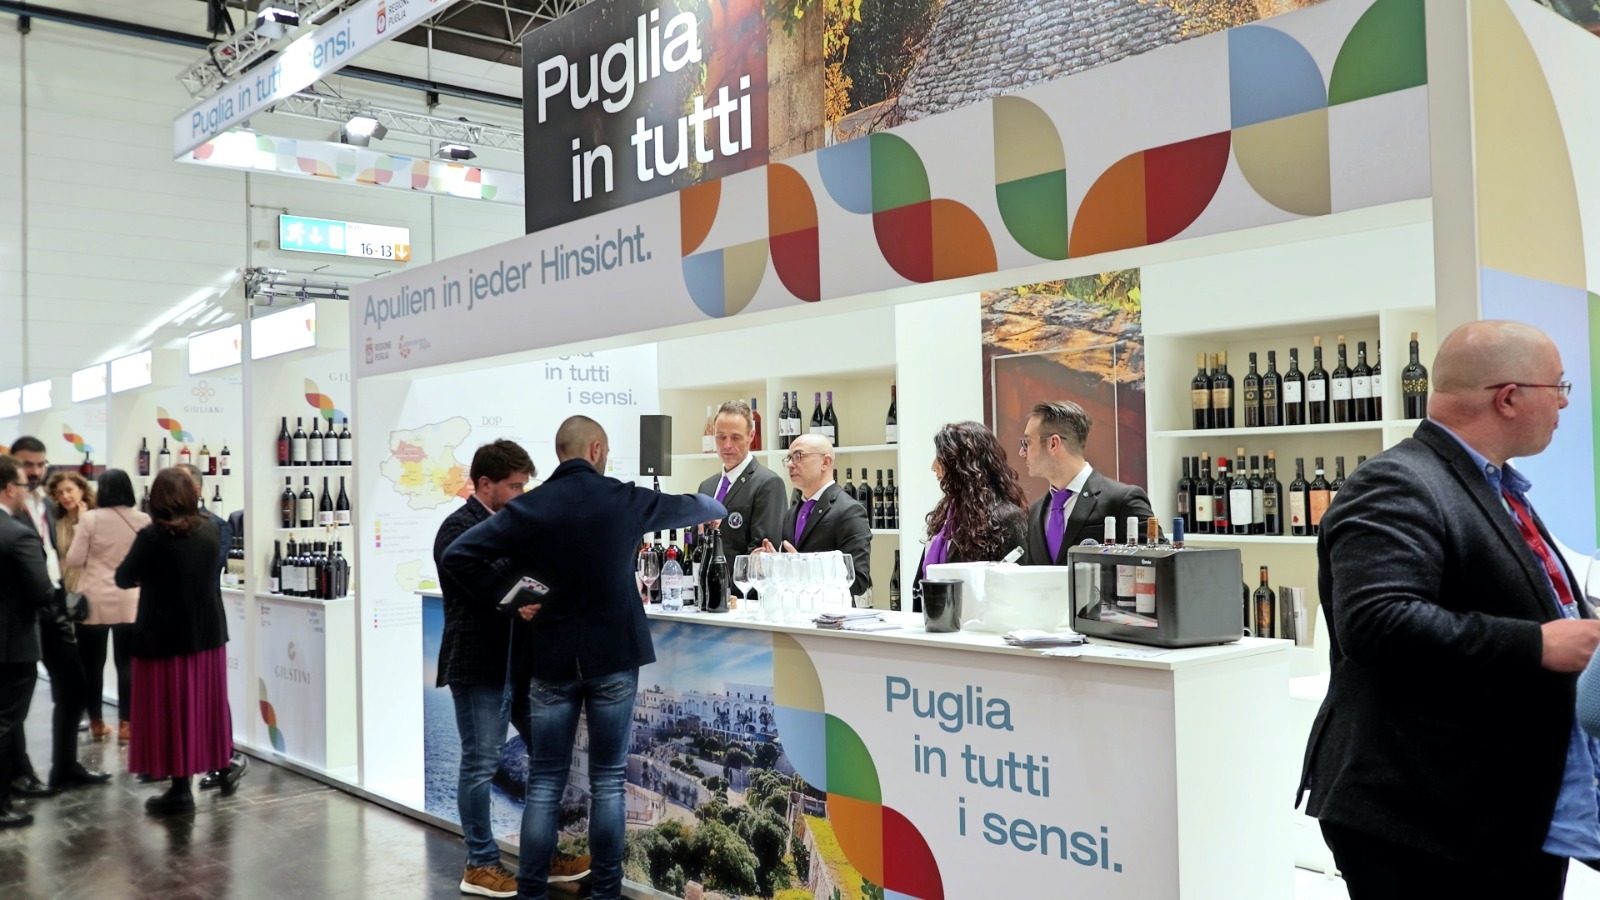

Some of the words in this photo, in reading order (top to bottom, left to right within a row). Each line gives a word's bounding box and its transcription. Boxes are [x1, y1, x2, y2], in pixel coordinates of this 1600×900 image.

[388, 9, 406, 26] PUGLIA
[192, 95, 234, 138] Puglia
[238, 85, 251, 113] in
[256, 66, 283, 101] tutt
[310, 20, 355, 69] ensi.
[537, 8, 702, 124] Puglia
[572, 138, 614, 203] in
[631, 74, 752, 182] tutti
[361, 243, 373, 255] 16
[381, 245, 392, 257] 13
[364, 285, 436, 330] Apulien
[443, 275, 461, 308] in
[467, 260, 532, 310] jeder
[541, 225, 652, 285] Hinsicht.
[545, 362, 562, 380] in
[569, 364, 609, 382] tutti
[567, 387, 572, 404] i
[579, 389, 637, 406] sensi.
[482, 416, 502, 426] DOP
[274, 665, 311, 685] GIUSTINI
[886, 675, 1014, 733] Puglia
[914, 734, 947, 778] in
[961, 744, 1050, 798] tutti
[959, 796, 966, 836] i
[982, 812, 1122, 873] sensi.
